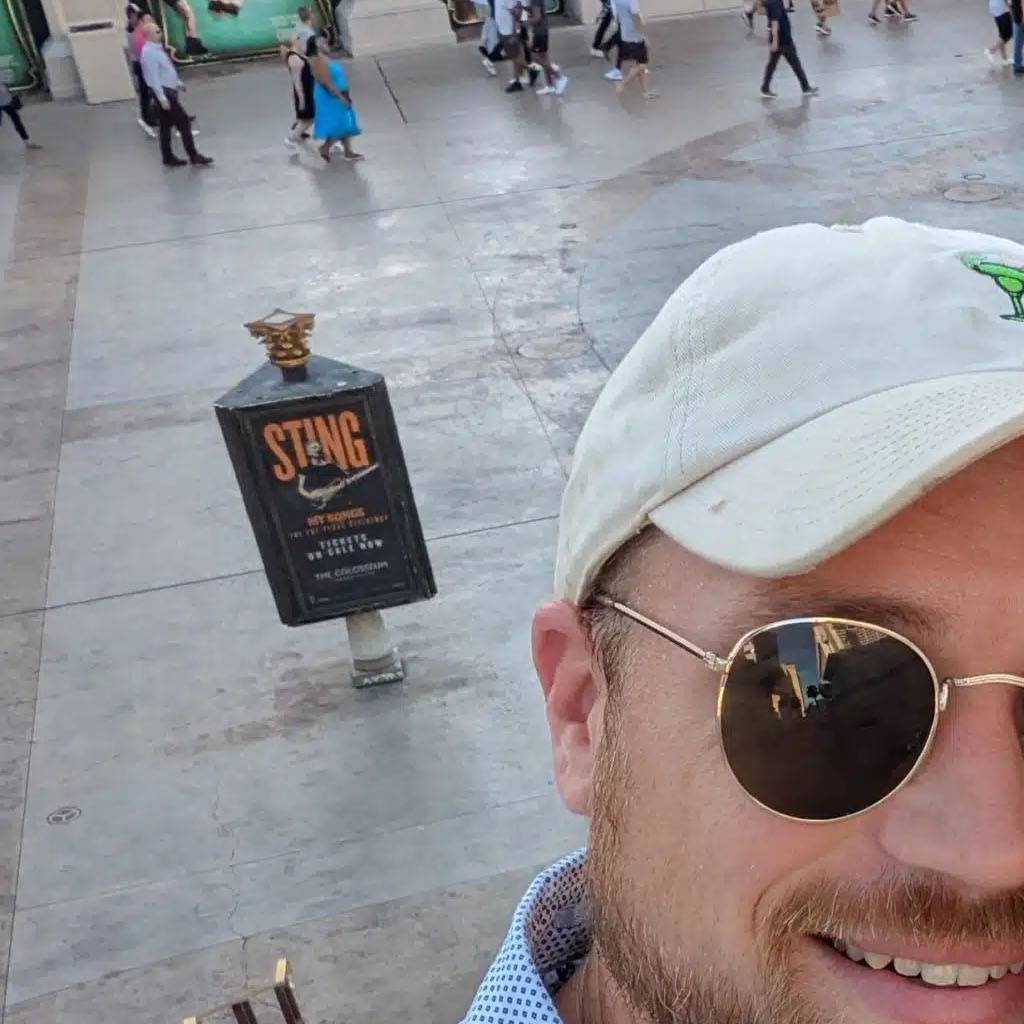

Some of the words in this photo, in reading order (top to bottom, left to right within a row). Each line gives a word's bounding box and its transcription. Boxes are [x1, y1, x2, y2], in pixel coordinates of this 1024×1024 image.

[263, 410, 369, 481] STING
[319, 533, 367, 550] TICKETS
[334, 560, 389, 578] COLOSSEUM
